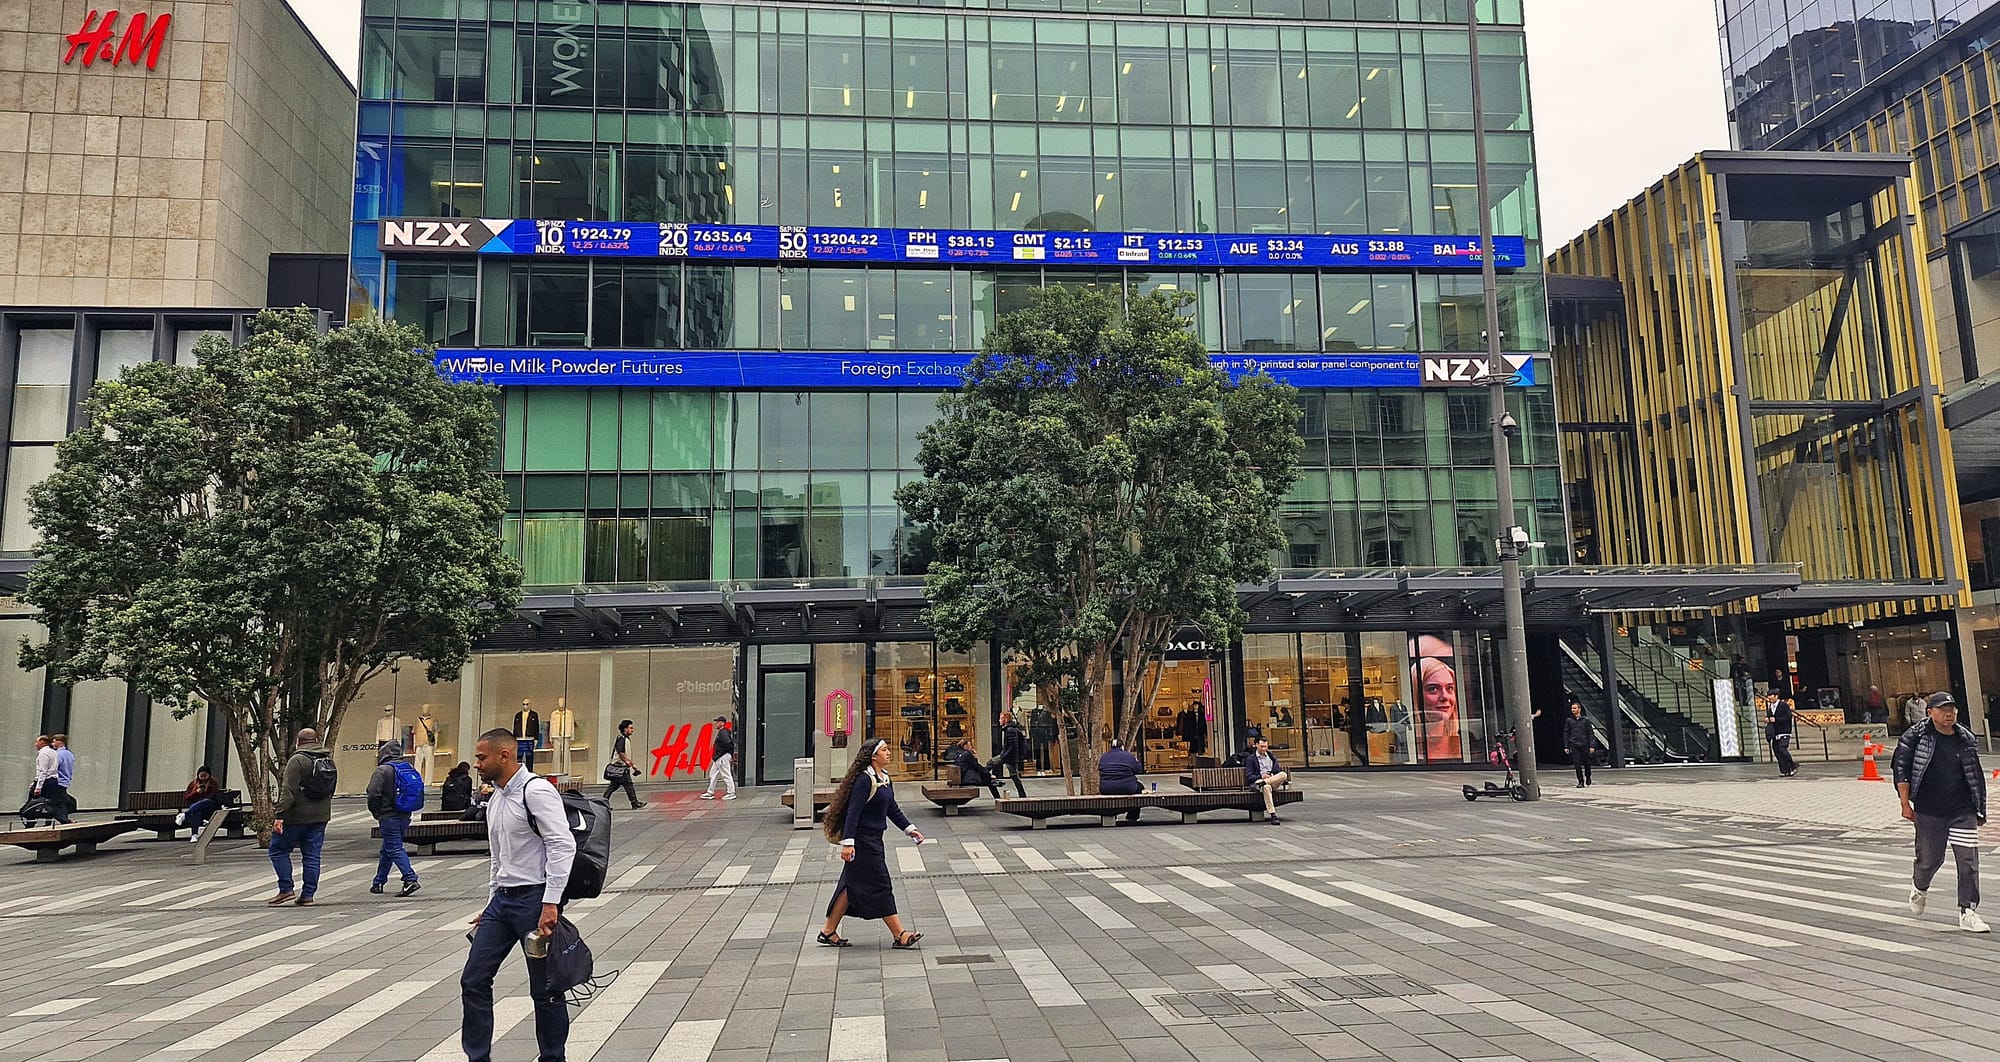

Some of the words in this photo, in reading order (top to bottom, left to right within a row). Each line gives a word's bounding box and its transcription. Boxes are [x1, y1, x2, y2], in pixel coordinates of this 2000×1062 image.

[63, 9, 172, 71] H&M
[384, 221, 472, 247] NZX
[538, 227, 563, 246] 10
[571, 228, 632, 241] 1924.79
[659, 230, 688, 248] 20
[693, 231, 753, 243] 7635.64
[812, 233, 878, 246] 13204.22
[908, 232, 937, 244] FPH
[1013, 233, 1046, 245] GMT
[572, 241, 593, 249] 12.25
[779, 232, 808, 250] 50
[948, 235, 995, 248] $38.15
[1054, 237, 1092, 249] $2.15
[1123, 235, 1144, 247] IFT
[1158, 238, 1203, 251] $12.53
[1267, 239, 1304, 251] $3.34
[1368, 240, 1405, 252] $3.88
[535, 245, 566, 254] INDEX
[659, 247, 689, 256] INDEX
[779, 249, 808, 258] INDEX
[1229, 243, 1258, 254] AUE
[1331, 243, 1359, 255] AUS
[448, 358, 504, 373] Whole
[511, 358, 546, 373] Milk
[552, 358, 616, 374] Powder
[622, 360, 683, 374] Futures
[841, 361, 901, 379] Foreign
[907, 361, 968, 375] Exchan
[1232, 359, 1240, 368] in
[1297, 360, 1319, 368] solar
[1322, 360, 1348, 370] panel
[1350, 360, 1405, 371] component
[1406, 360, 1420, 369] for
[342, 744, 359, 752] S/S
